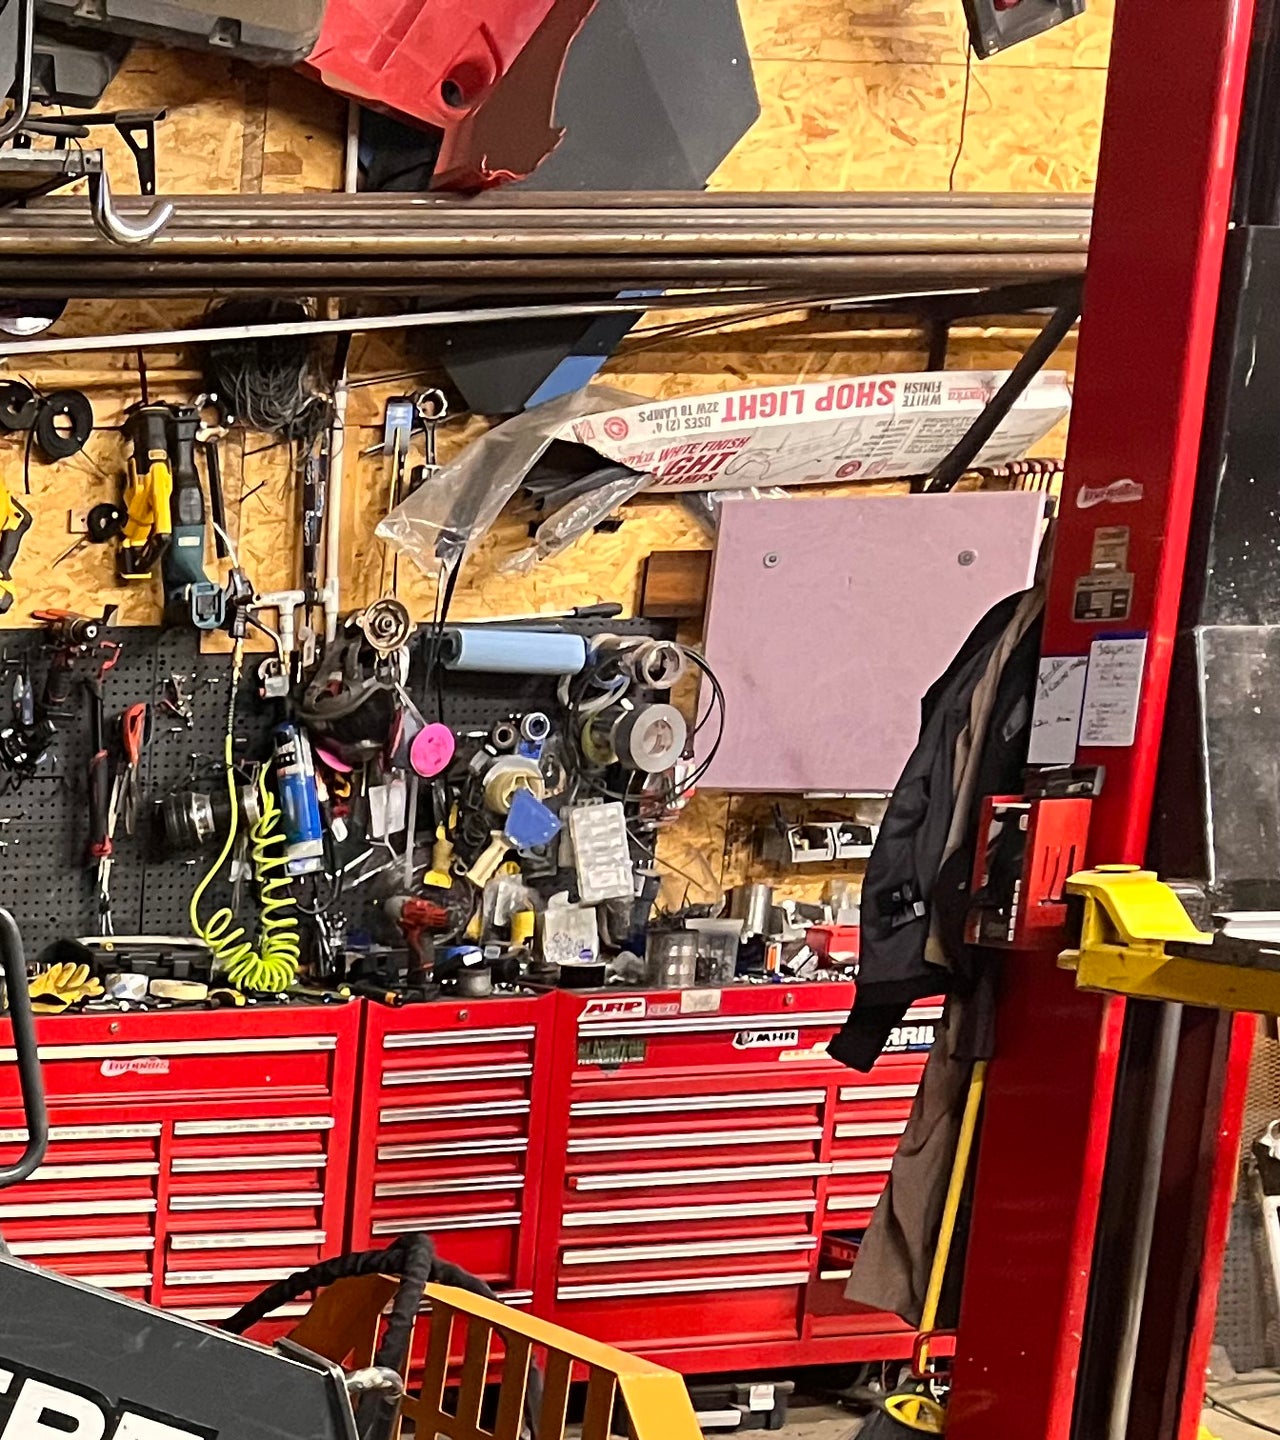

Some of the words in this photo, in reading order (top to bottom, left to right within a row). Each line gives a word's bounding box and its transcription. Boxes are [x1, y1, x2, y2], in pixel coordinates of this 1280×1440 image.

[903, 381, 942, 393] FINISH
[815, 380, 897, 412] SHOP
[902, 395, 942, 407] WHITE
[697, 401, 720, 415] 32W
[721, 388, 805, 423] LIGHT
[639, 406, 678, 423] LAMPS
[684, 416, 711, 429] USES
[658, 441, 702, 461] WHITE
[703, 435, 751, 454] FINISH
[586, 1001, 642, 1015] ARP
[756, 1031, 796, 1043] MHR
